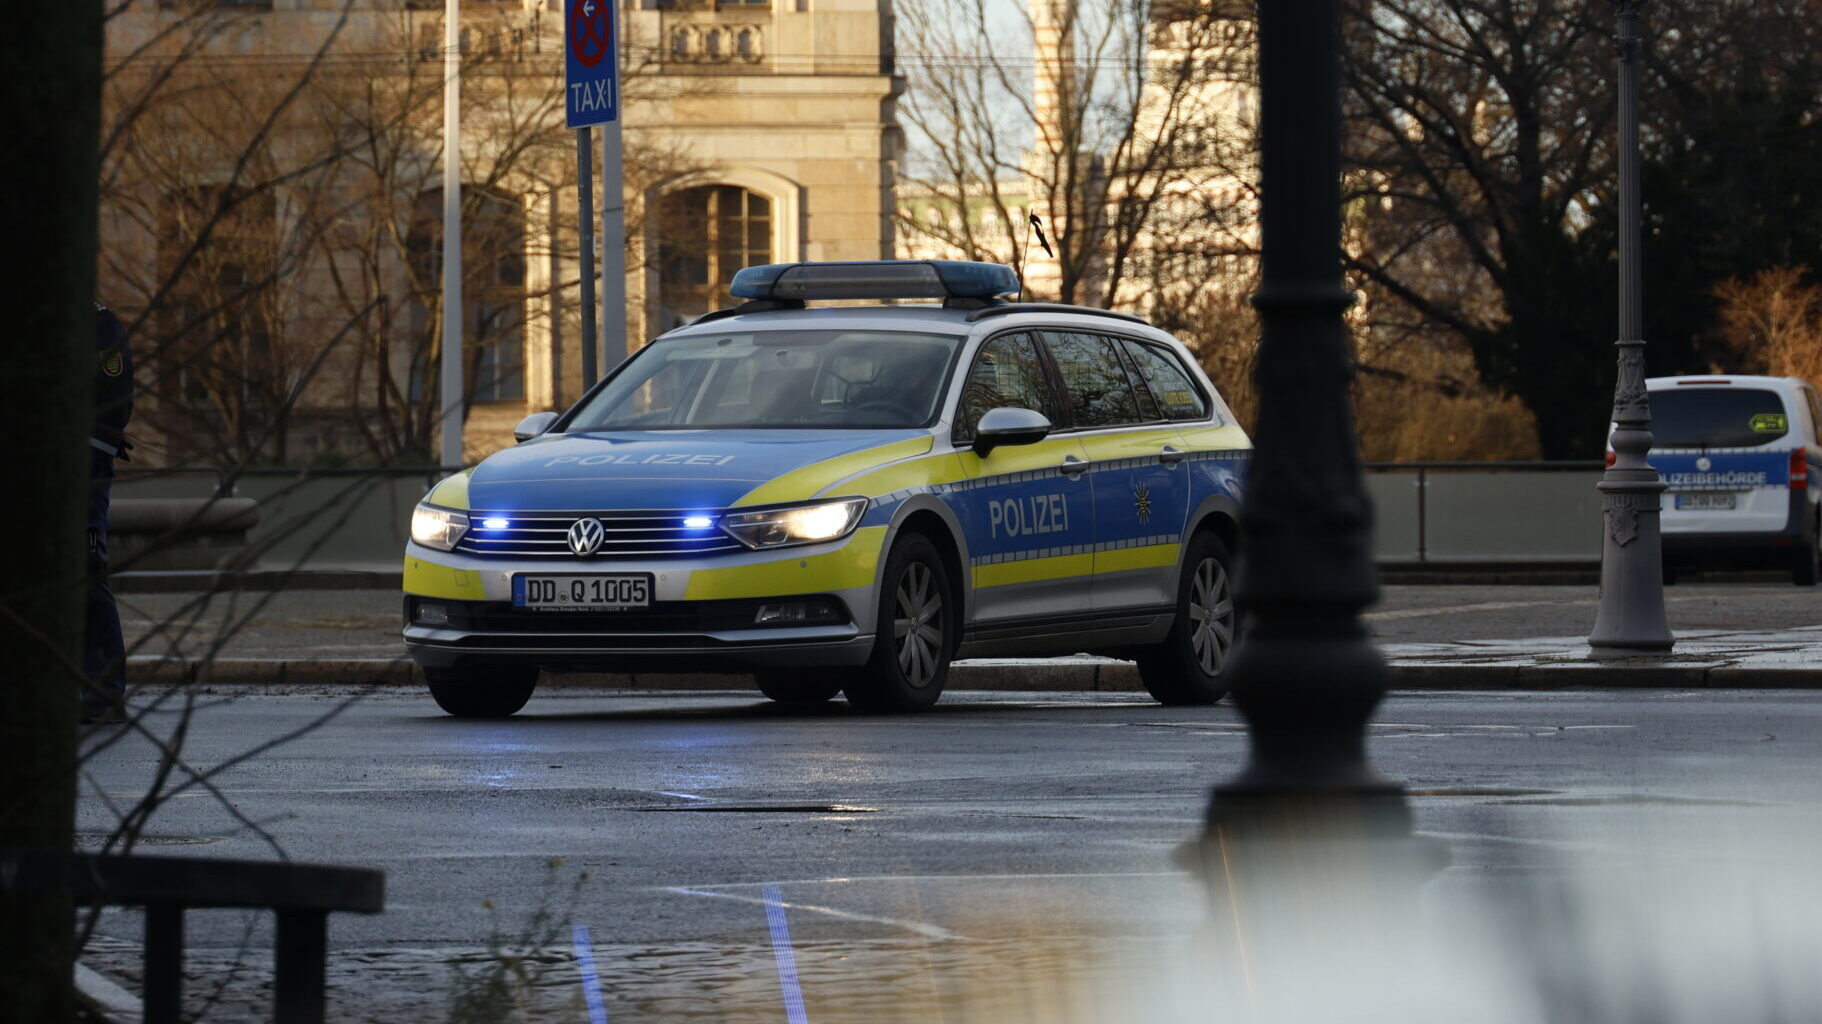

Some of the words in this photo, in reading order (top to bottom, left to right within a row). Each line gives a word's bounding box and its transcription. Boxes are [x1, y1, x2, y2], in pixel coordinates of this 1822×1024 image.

[571, 78, 611, 113] TAXI
[544, 454, 736, 468] POLIZEI
[1659, 471, 1767, 485] LIZEIBEHÖRDE
[988, 493, 1069, 539] POLIZEI
[527, 579, 556, 603] DD
[571, 579, 585, 603] Q
[590, 579, 647, 603] 1005
